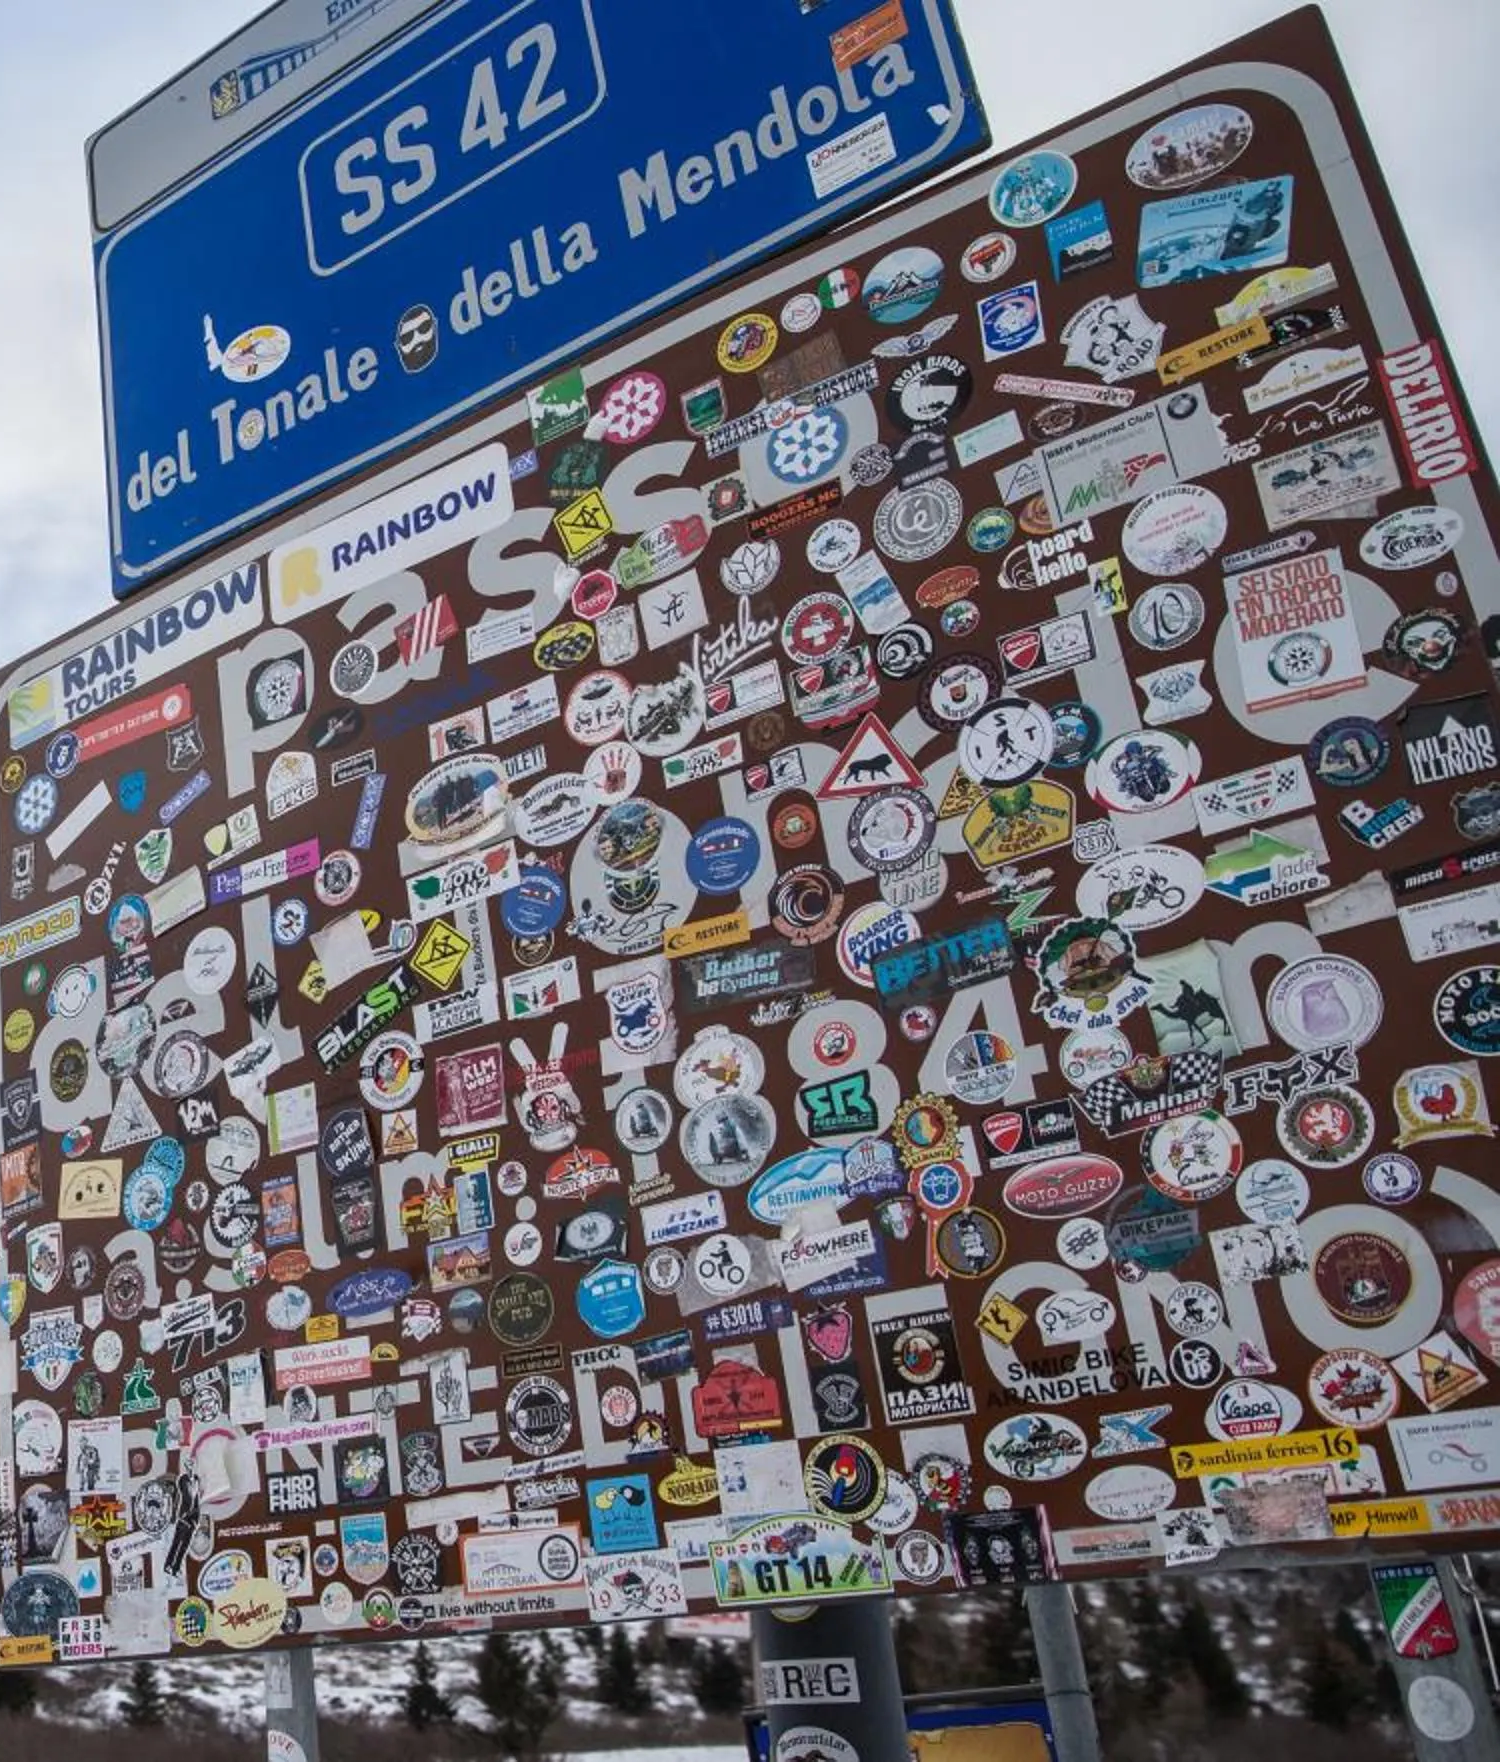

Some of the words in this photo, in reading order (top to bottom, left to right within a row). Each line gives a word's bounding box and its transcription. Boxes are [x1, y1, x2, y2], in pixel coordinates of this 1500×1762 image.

[334, 105, 438, 234] SS
[460, 23, 567, 154] 42
[127, 428, 197, 512] del
[211, 345, 379, 465] Tonale
[449, 221, 599, 335] della
[617, 43, 916, 239] Mendola
[1382, 343, 1471, 482] DELIRIO
[331, 472, 496, 572] RAINBOW
[1028, 522, 1095, 563] board
[1238, 571, 1267, 597] SEI
[1272, 555, 1330, 586] STATO
[1235, 595, 1265, 622] FIN
[1267, 576, 1342, 613] TROPPO
[1240, 597, 1345, 643] MODERATO
[60, 564, 259, 699] RAINBOW
[64, 670, 138, 721] TOURS
[1405, 724, 1494, 767] MILANO
[1410, 744, 1499, 785] ILLINOIS
[1369, 805, 1425, 849] CREW
[847, 909, 905, 953] BOARDER
[852, 923, 909, 970] KING
[317, 971, 413, 1063] BLAST
[1439, 976, 1474, 1025] MOTO
[1119, 1083, 1211, 1122] Malnat
[1016, 1188, 1062, 1204] MOTO
[1066, 1175, 1114, 1197] GUZZI
[1118, 1211, 1191, 1238] BIKEPARK
[168, 1298, 247, 1372] 713
[1007, 1354, 1079, 1391] SIMIC
[1087, 1342, 1149, 1379] BIKE
[1199, 1443, 1263, 1467] sardinia
[1266, 1443, 1319, 1462] ferries
[1322, 1429, 1354, 1456] 16
[269, 1476, 316, 1495] FHRD
[269, 1493, 317, 1513] FHRN
[1366, 1507, 1420, 1526] Hinwil
[756, 1560, 790, 1593] GT
[800, 1556, 833, 1589] 14
[439, 1602, 461, 1618] live
[464, 1598, 516, 1616] without
[518, 1594, 555, 1611] limits
